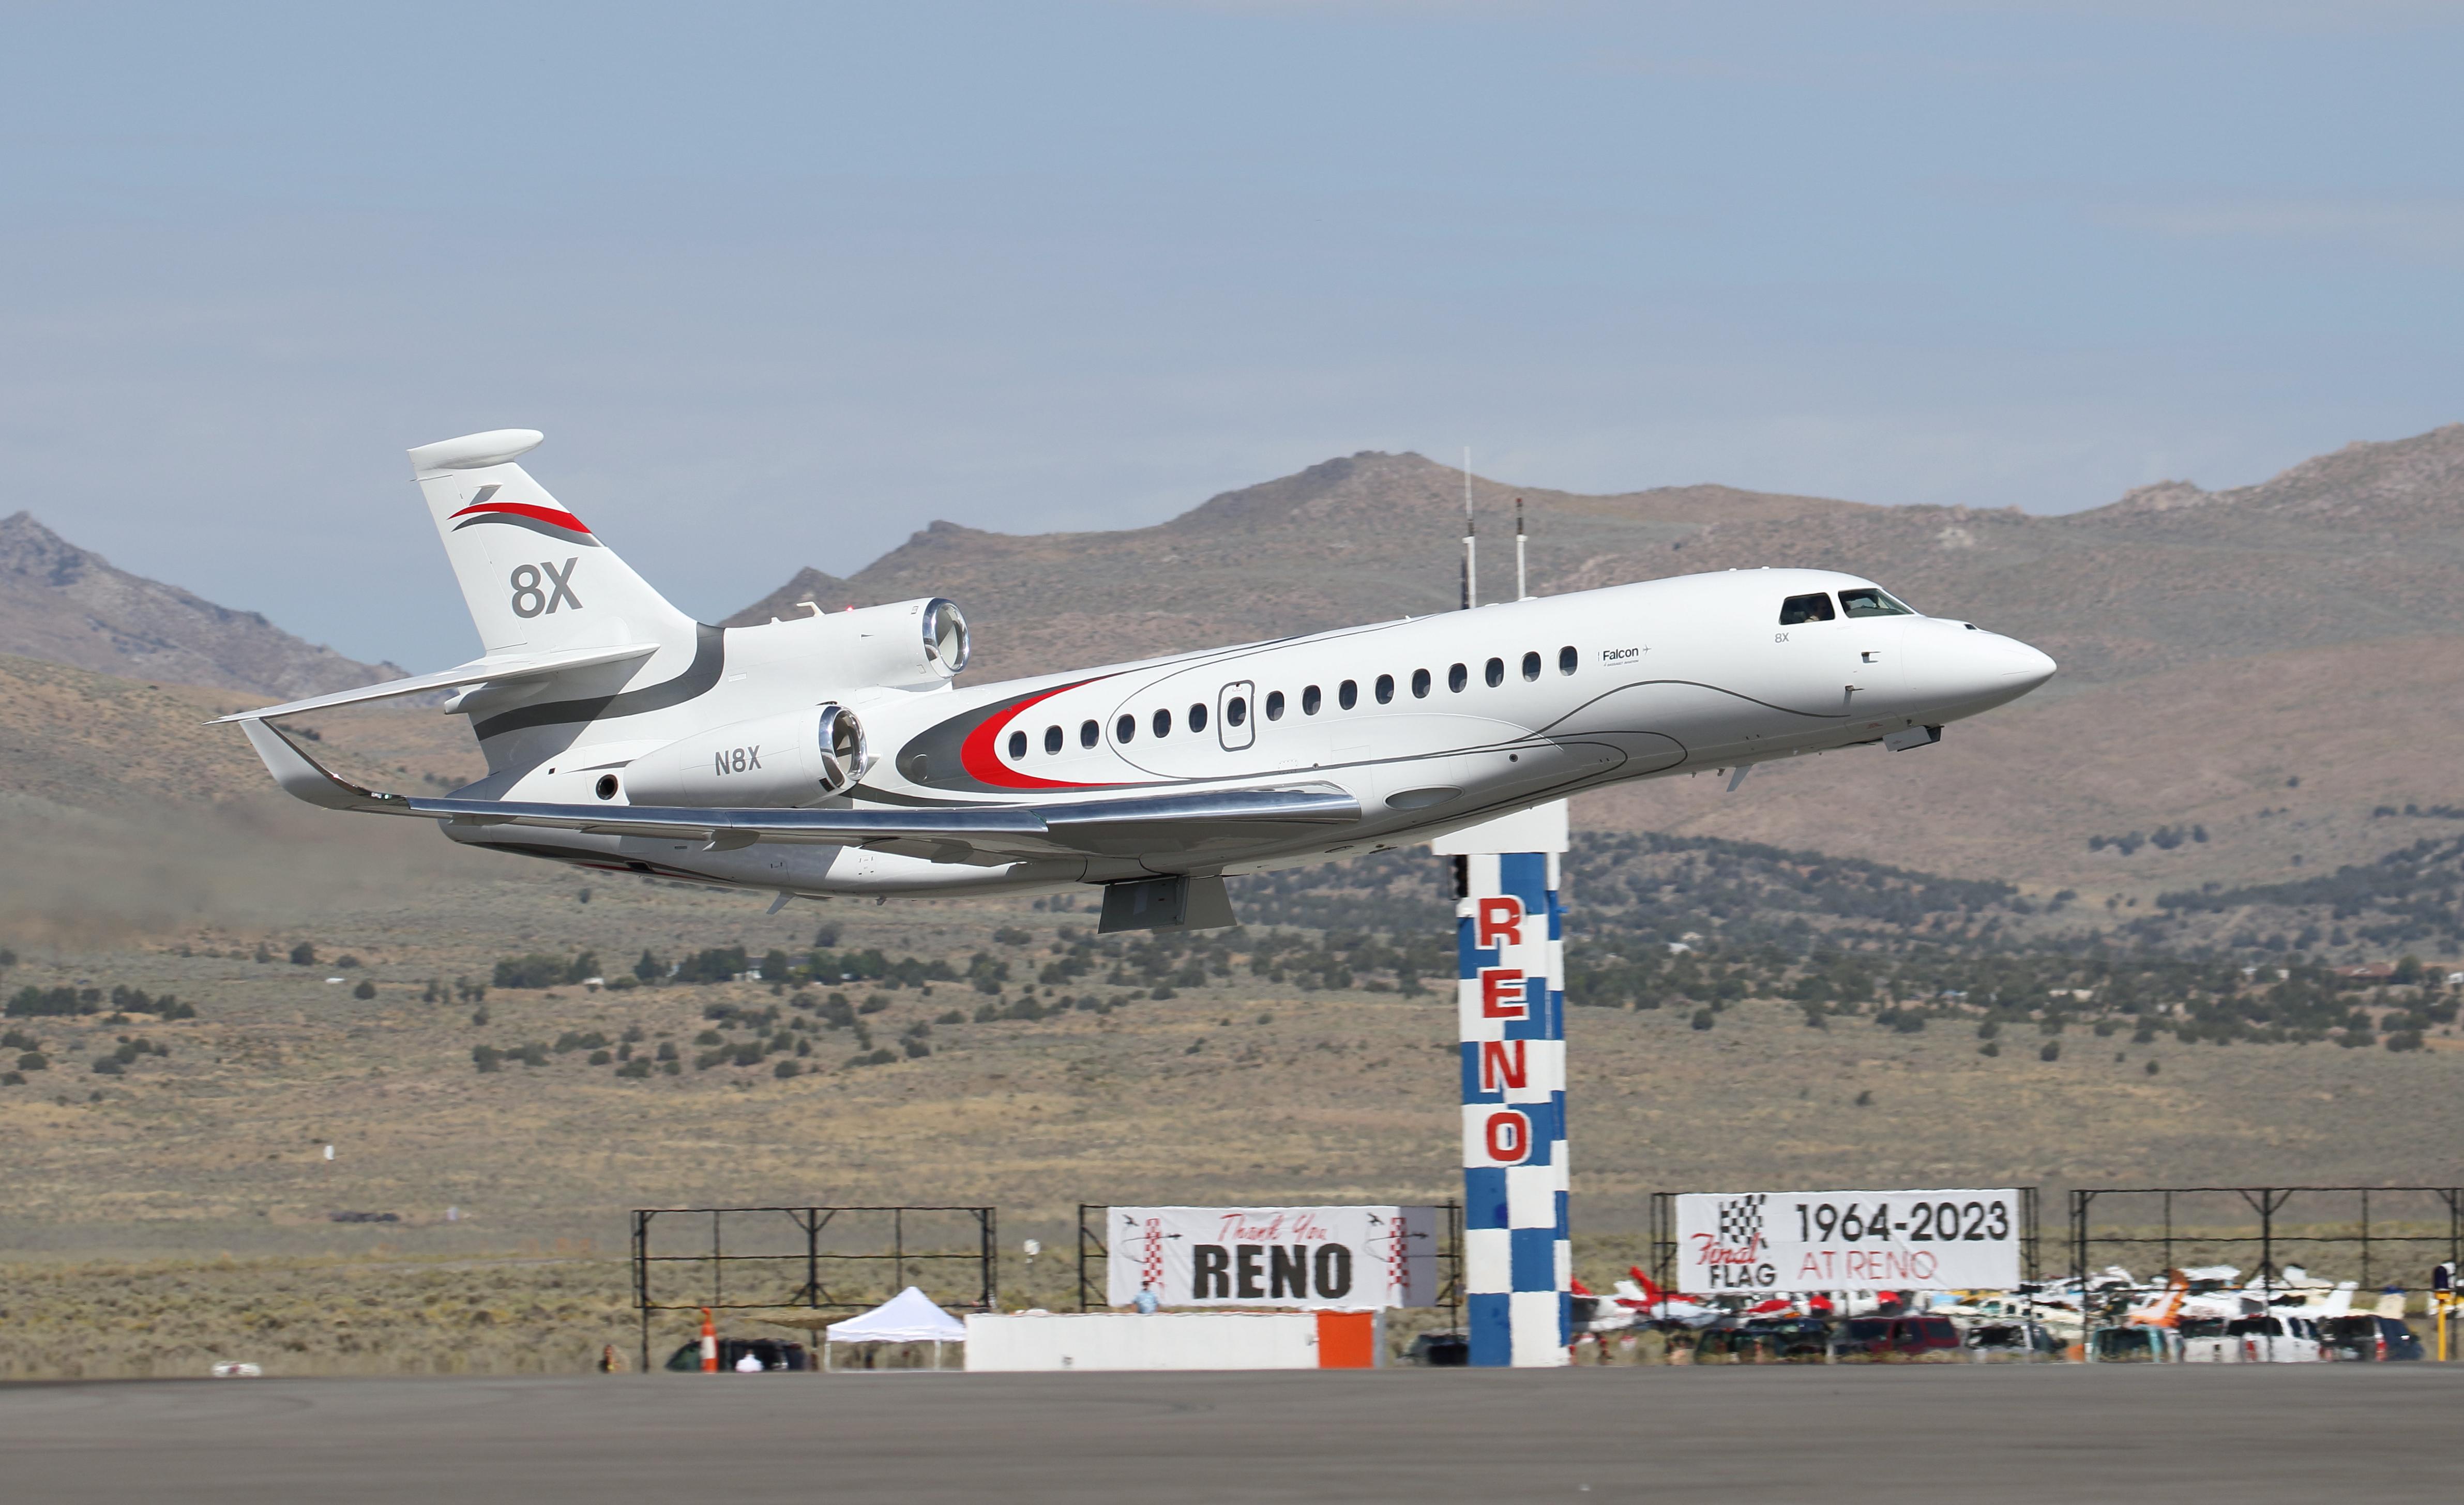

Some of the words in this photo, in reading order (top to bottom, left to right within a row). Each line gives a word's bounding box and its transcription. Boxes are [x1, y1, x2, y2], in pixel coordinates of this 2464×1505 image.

[511, 557, 583, 618] 8X
[1775, 632, 1789, 643] 8X
[1603, 648, 1638, 661] Falcon
[715, 744, 762, 776] N8X
[1479, 897, 1527, 1161] RENO
[1217, 1213, 1284, 1241] Thank
[1292, 1213, 1327, 1242] You
[1796, 1201, 2008, 1242] 1964-2023
[1690, 1232, 1762, 1265] Final
[1193, 1243, 1352, 1299] RENO
[1710, 1263, 1776, 1288] FLAG
[1797, 1251, 1836, 1280] AT
[1846, 1251, 1938, 1280] RENO
